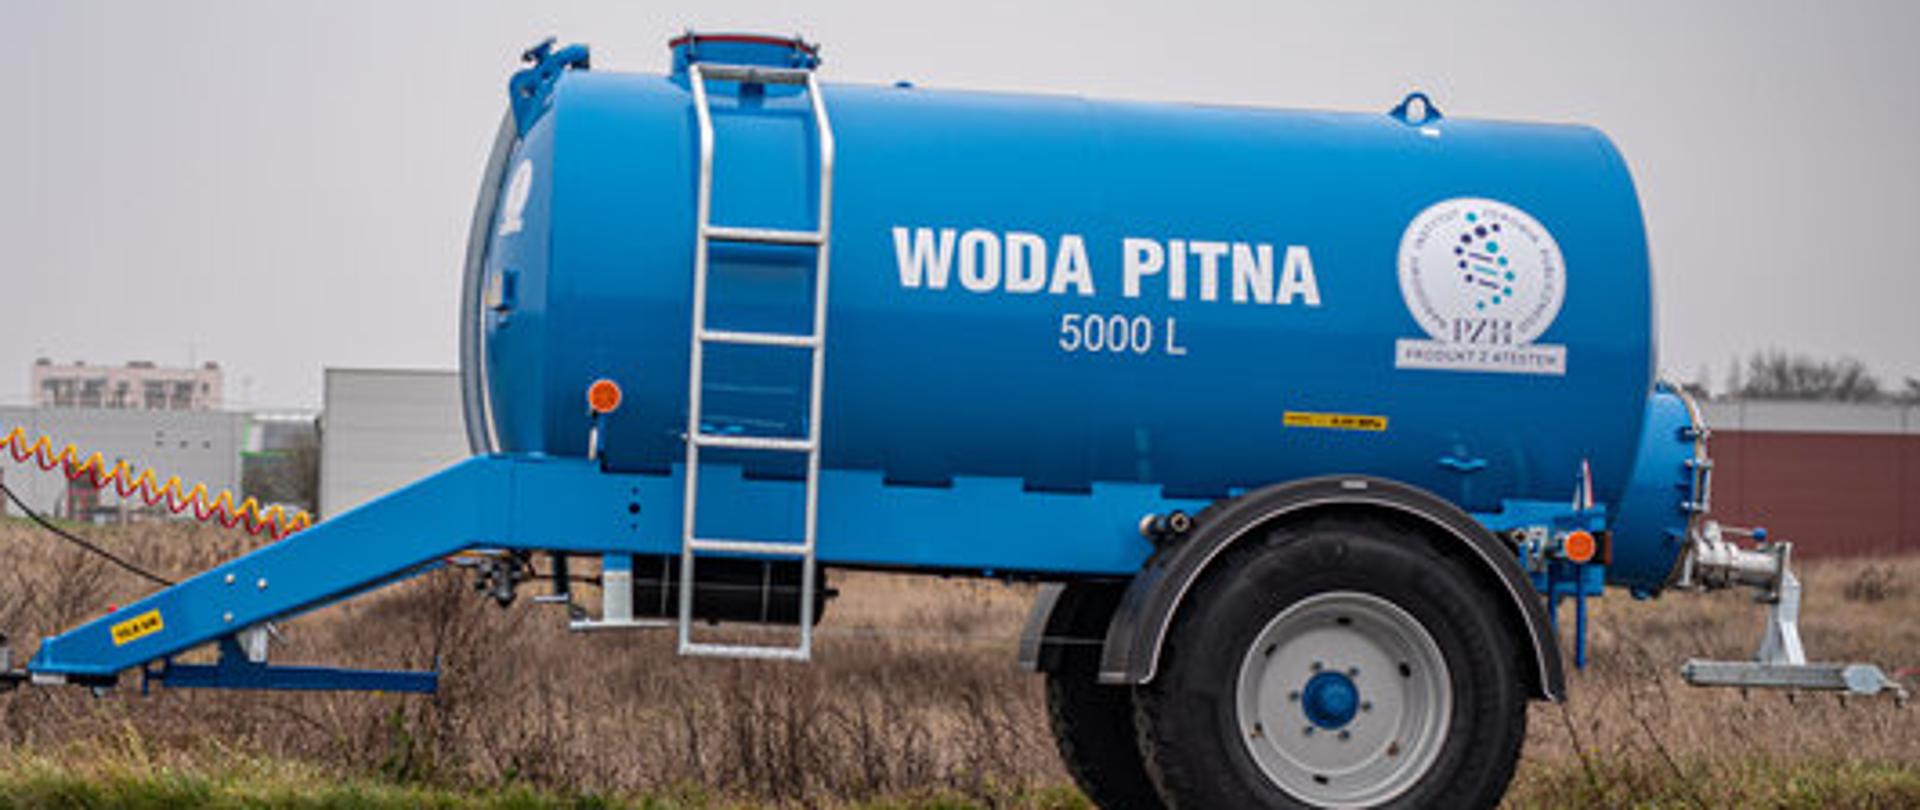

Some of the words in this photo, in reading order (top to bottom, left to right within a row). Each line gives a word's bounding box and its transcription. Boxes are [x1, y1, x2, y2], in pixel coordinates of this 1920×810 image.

[892, 226, 1096, 297] WODA
[1121, 237, 1322, 306] PITNA
[1058, 314, 1152, 354] 5000
[1166, 317, 1187, 356] L
[1453, 317, 1513, 345] PZH
[1405, 348, 1476, 363] PRODUKT
[1478, 350, 1488, 363] Z
[1491, 351, 1557, 367] ATESTEM
